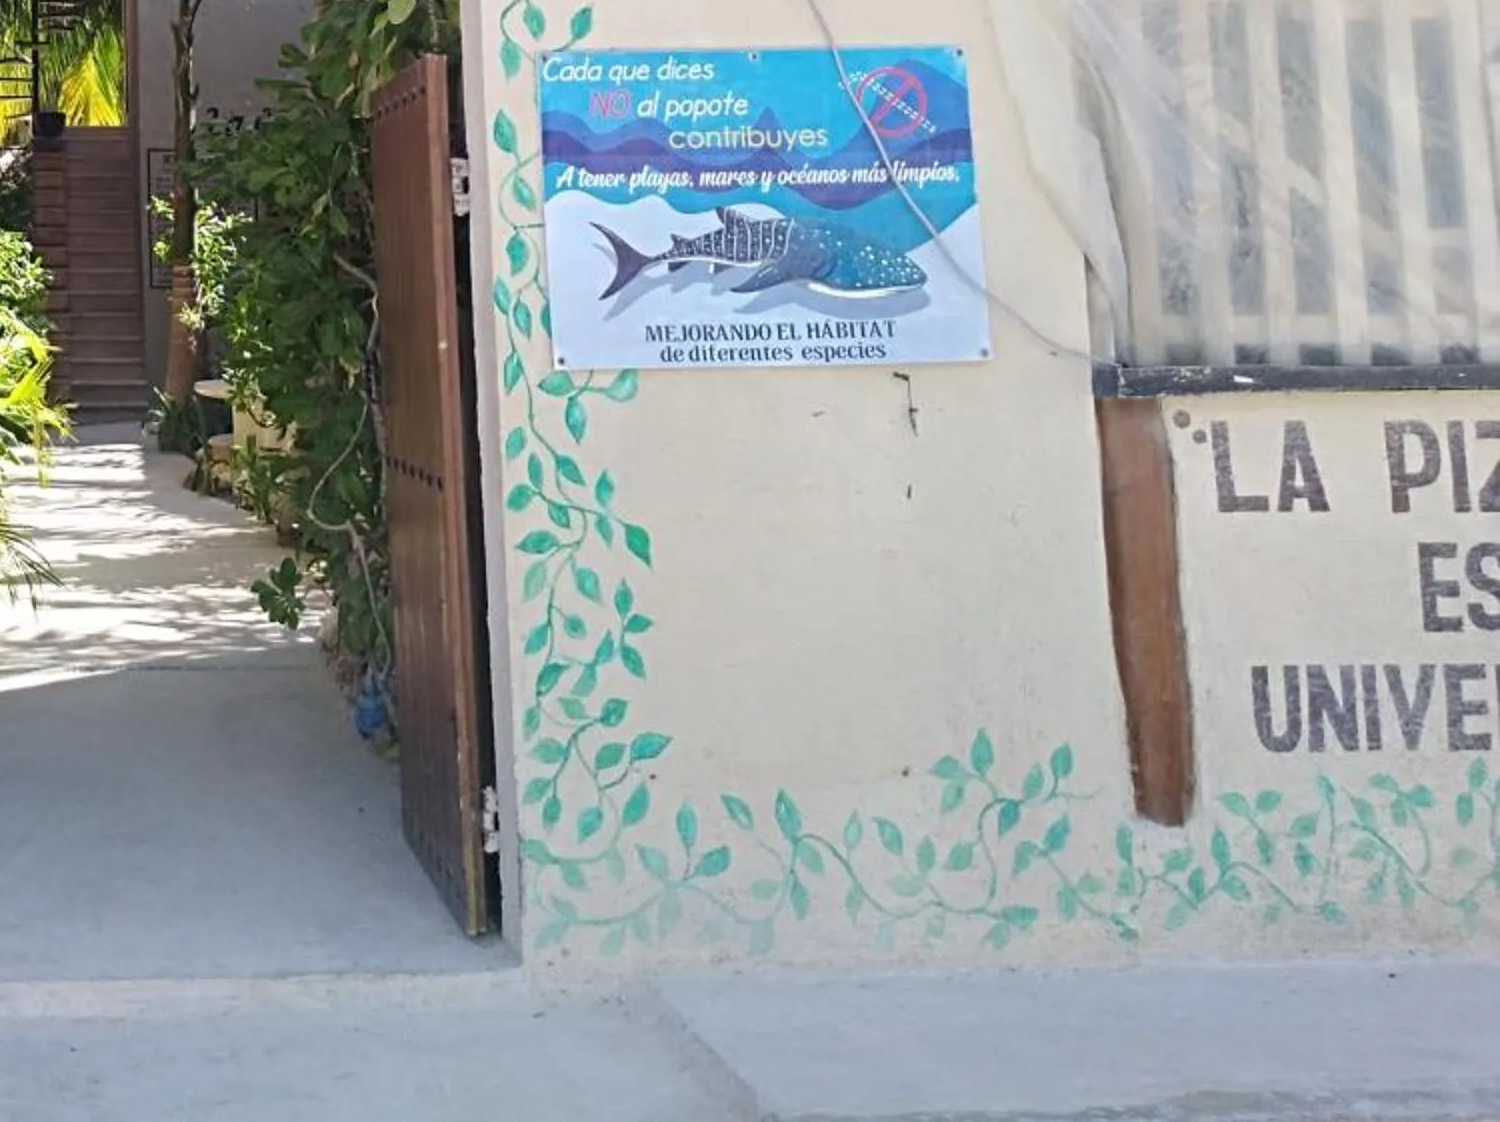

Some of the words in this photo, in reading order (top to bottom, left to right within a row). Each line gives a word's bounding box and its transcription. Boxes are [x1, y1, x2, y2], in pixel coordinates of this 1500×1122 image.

[543, 57, 601, 82] Cada
[608, 64, 650, 88] que
[656, 56, 715, 80] dices
[589, 91, 631, 118] NO
[637, 90, 660, 118] al
[664, 91, 749, 121] popote
[668, 126, 829, 151] contribuyes
[556, 166, 575, 189] A
[579, 169, 625, 187] tener
[699, 170, 758, 187] mares
[761, 171, 774, 192] y
[777, 163, 848, 185] océanos
[852, 161, 887, 183] más
[646, 322, 772, 343] MEJORANDO
[777, 322, 800, 341] EL
[806, 318, 897, 340] HÁBITAT
[660, 346, 684, 363] de
[688, 345, 793, 363] diferentes
[801, 343, 887, 362] especies
[1210, 420, 1331, 513] LA
[1252, 663, 1500, 753] UNIVE
